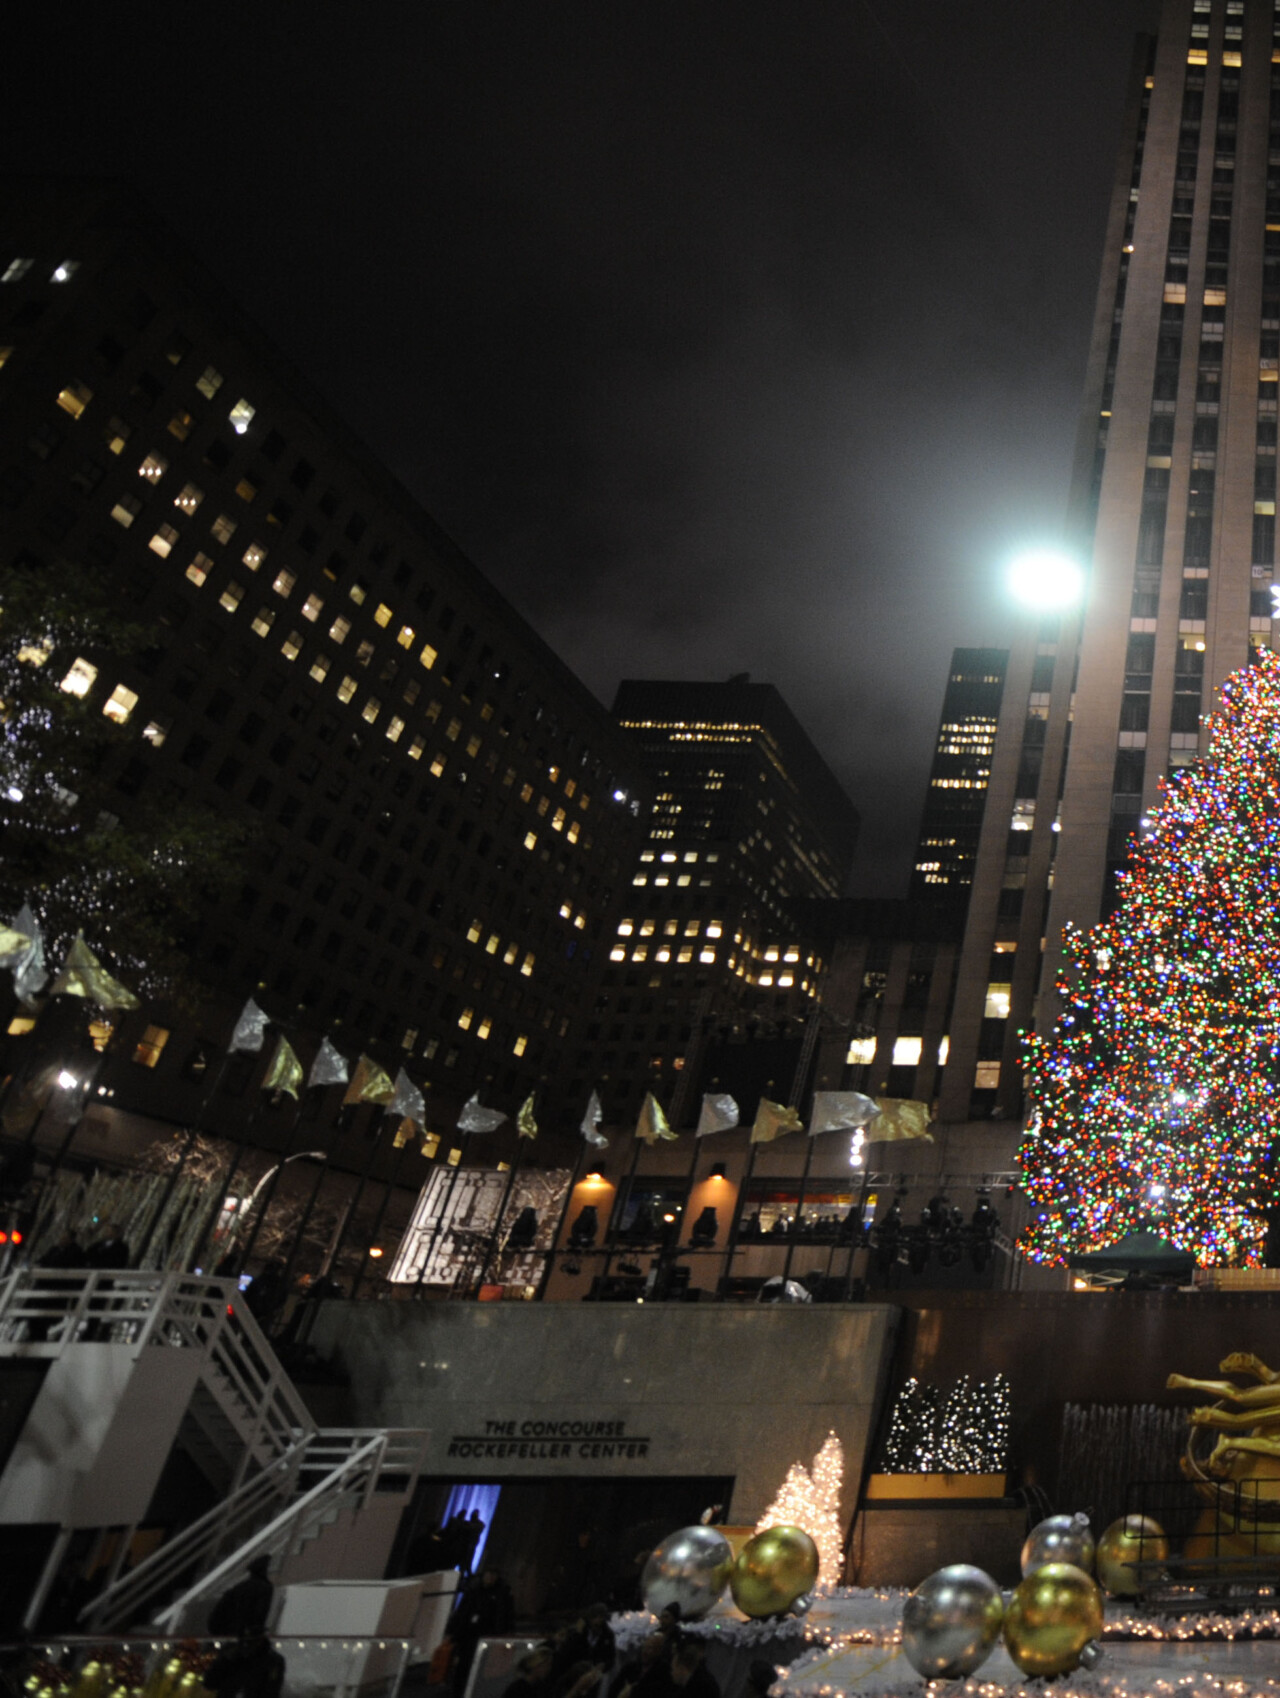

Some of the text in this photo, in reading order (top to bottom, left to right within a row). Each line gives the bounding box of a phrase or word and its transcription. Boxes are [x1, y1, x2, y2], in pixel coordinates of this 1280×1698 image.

[485, 1421, 626, 1437] THE CONCOURSE
[448, 1443, 650, 1459] ROCKEFELLER CENTER
